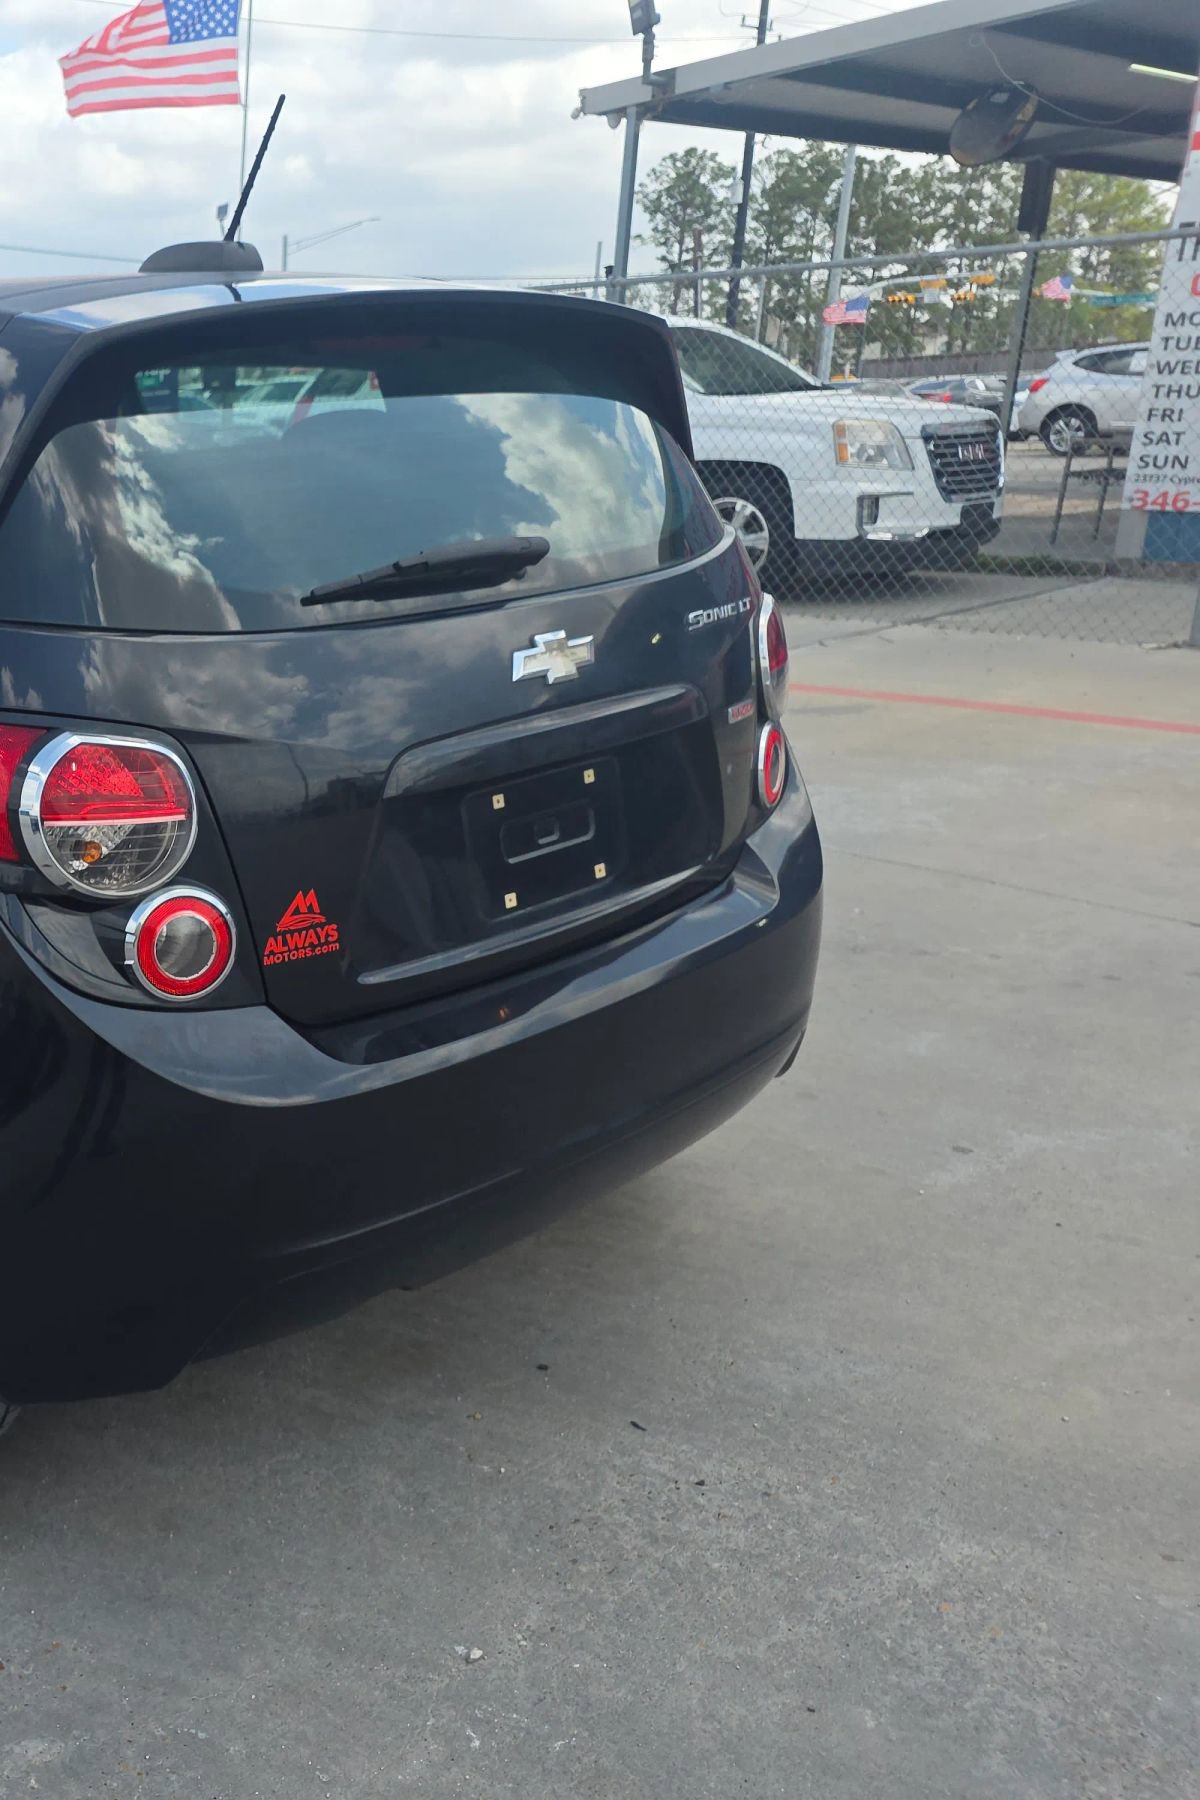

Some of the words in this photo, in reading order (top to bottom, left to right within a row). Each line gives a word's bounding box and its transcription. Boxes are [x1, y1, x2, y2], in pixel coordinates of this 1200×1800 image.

[1152, 384, 1200, 399] THU
[1147, 408, 1183, 422] FRI
[1141, 431, 1186, 446] SAT
[1137, 454, 1189, 470] SUN
[688, 602, 738, 631] SONIC
[738, 597, 752, 613] LT
[264, 924, 338, 955] ALWAYS
[263, 943, 340, 966] MOTORS.com
